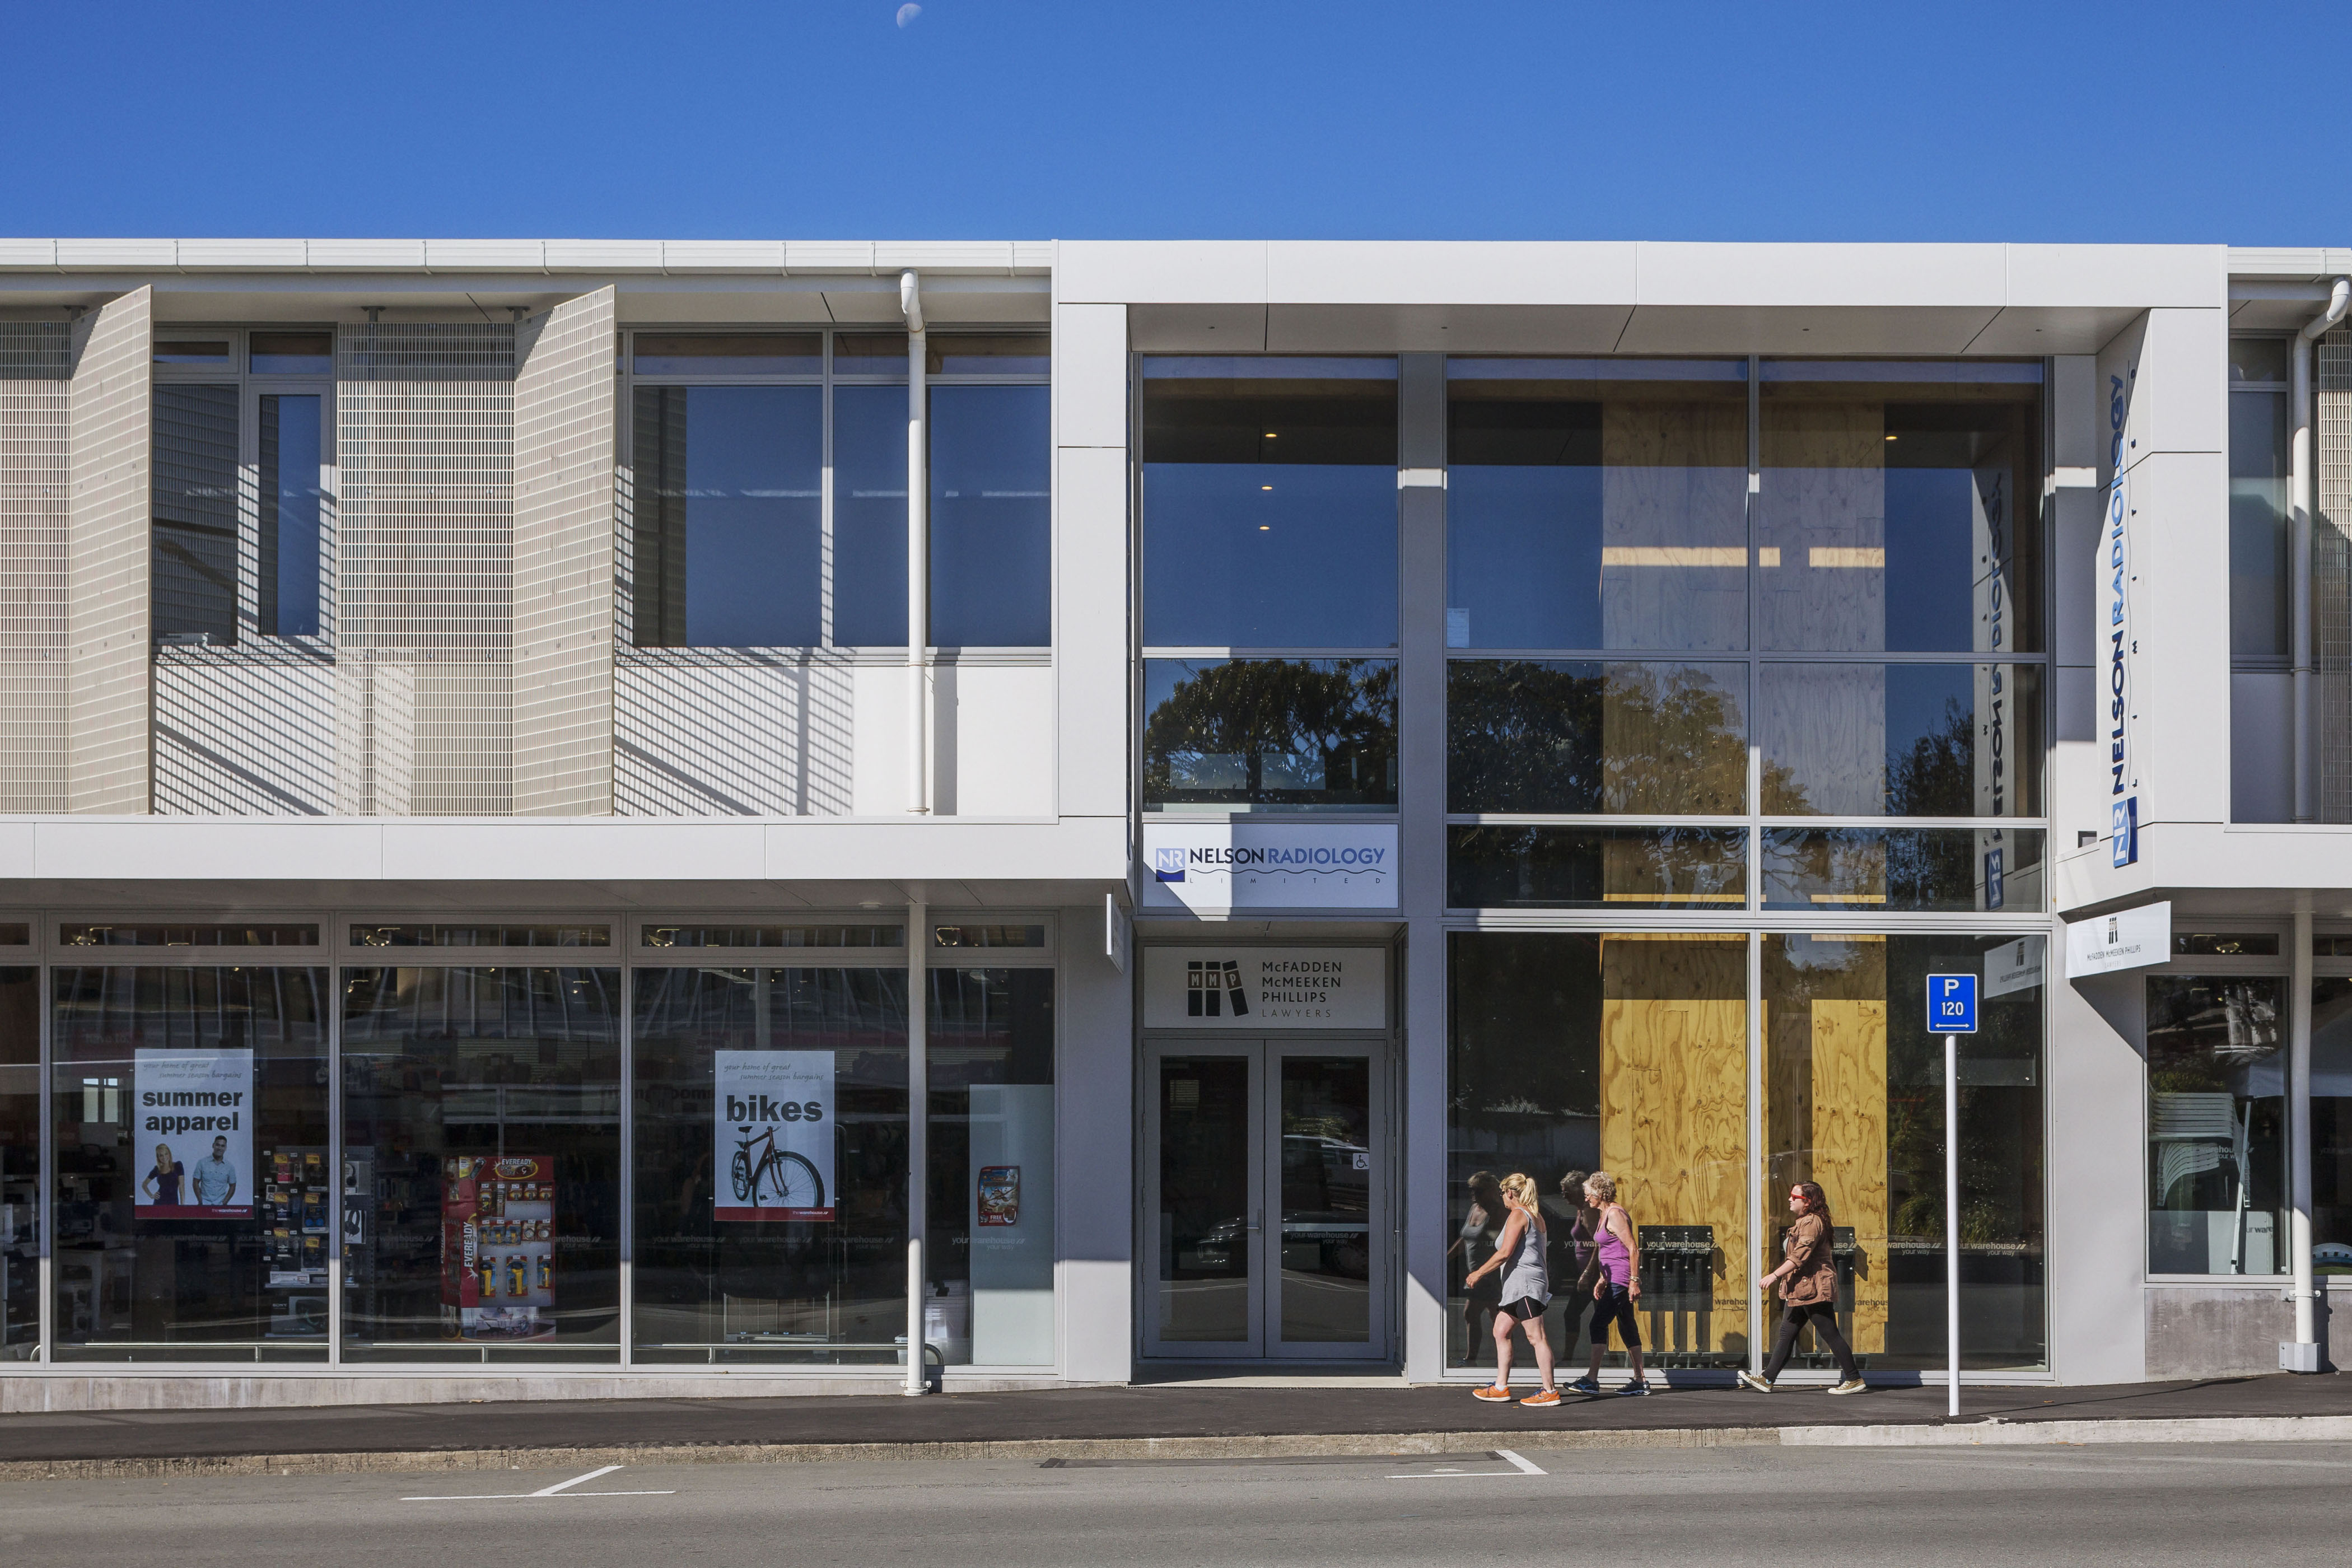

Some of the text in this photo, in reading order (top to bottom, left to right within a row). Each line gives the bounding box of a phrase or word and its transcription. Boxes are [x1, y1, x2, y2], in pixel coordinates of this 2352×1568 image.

[2110, 374, 2124, 627] RADIOLOGY
[2112, 629, 2125, 795] NELSON
[1189, 848, 1385, 864] NELSON RADIOLOGY
[2087, 945, 2141, 961] McFADDEN McMEEKEN PHILLIPS
[1262, 962, 1342, 972] McFADDEN
[1262, 977, 1341, 987] McMEEKEN
[1944, 979, 1959, 997] P
[1262, 992, 1327, 1002] PHILLIPS
[1262, 1009, 1331, 1018] LAWYERS
[1942, 1001, 1964, 1015] 120
[190, 1062, 209, 1071] great
[724, 1064, 740, 1072] your
[763, 1062, 771, 1072] of
[771, 1063, 791, 1072] great
[212, 1071, 242, 1081] bargains
[793, 1072, 824, 1082] bargains
[142, 1092, 243, 1107] summer
[727, 1095, 823, 1122] bikes
[146, 1112, 239, 1135] apparel
[464, 1221, 474, 1268] EVEREADY
[757, 1234, 802, 1243] warehouse
[952, 1237, 969, 1245] your
